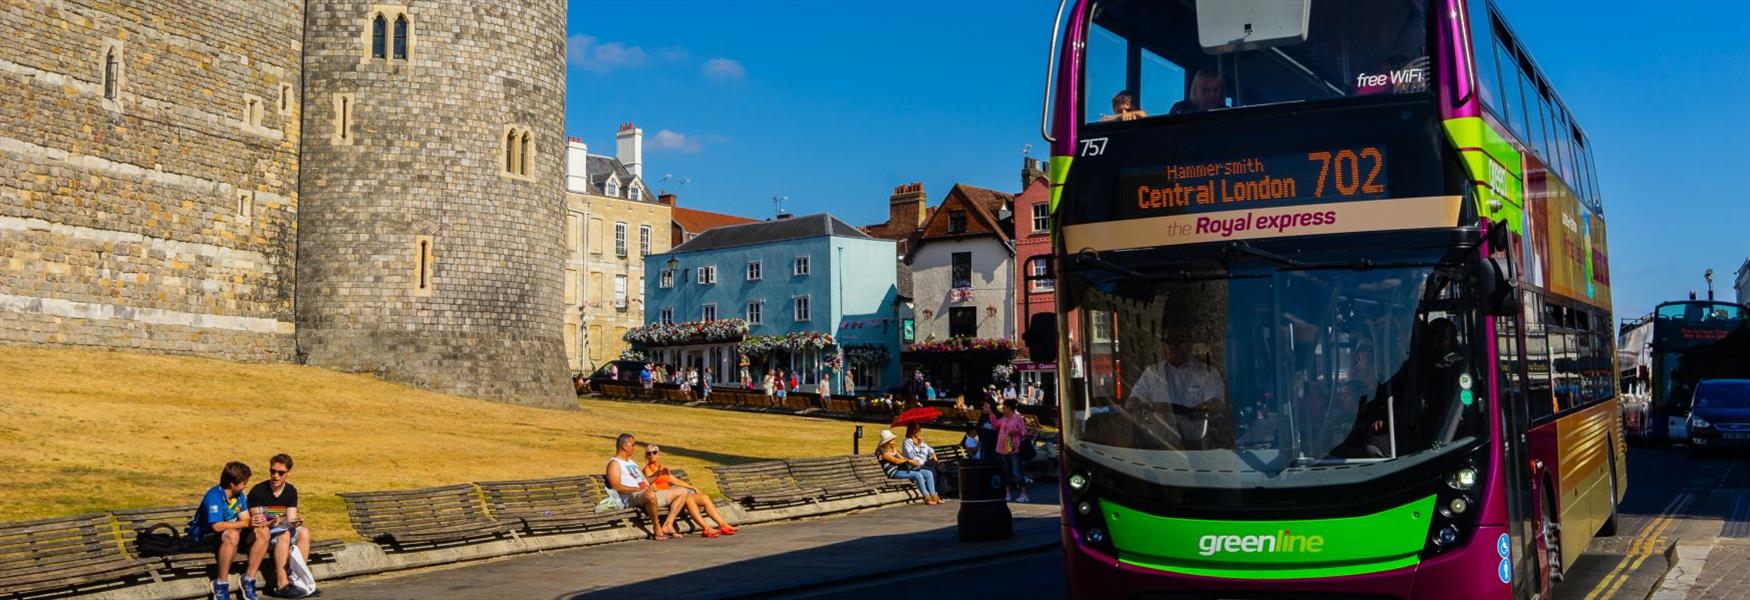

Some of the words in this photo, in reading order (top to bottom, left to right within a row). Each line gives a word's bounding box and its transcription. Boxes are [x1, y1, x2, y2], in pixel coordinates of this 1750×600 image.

[1356, 72, 1387, 88] free
[1390, 68, 1422, 85] WiFi
[1080, 137, 1109, 157] 757
[1167, 158, 1264, 180] Hammersmith
[1308, 147, 1384, 198] 702
[1138, 179, 1215, 209] Central
[1221, 175, 1296, 204] London
[1167, 221, 1192, 237] the
[1195, 213, 1252, 237] Royal
[1256, 210, 1336, 233] express
[1199, 529, 1324, 556] greenline
